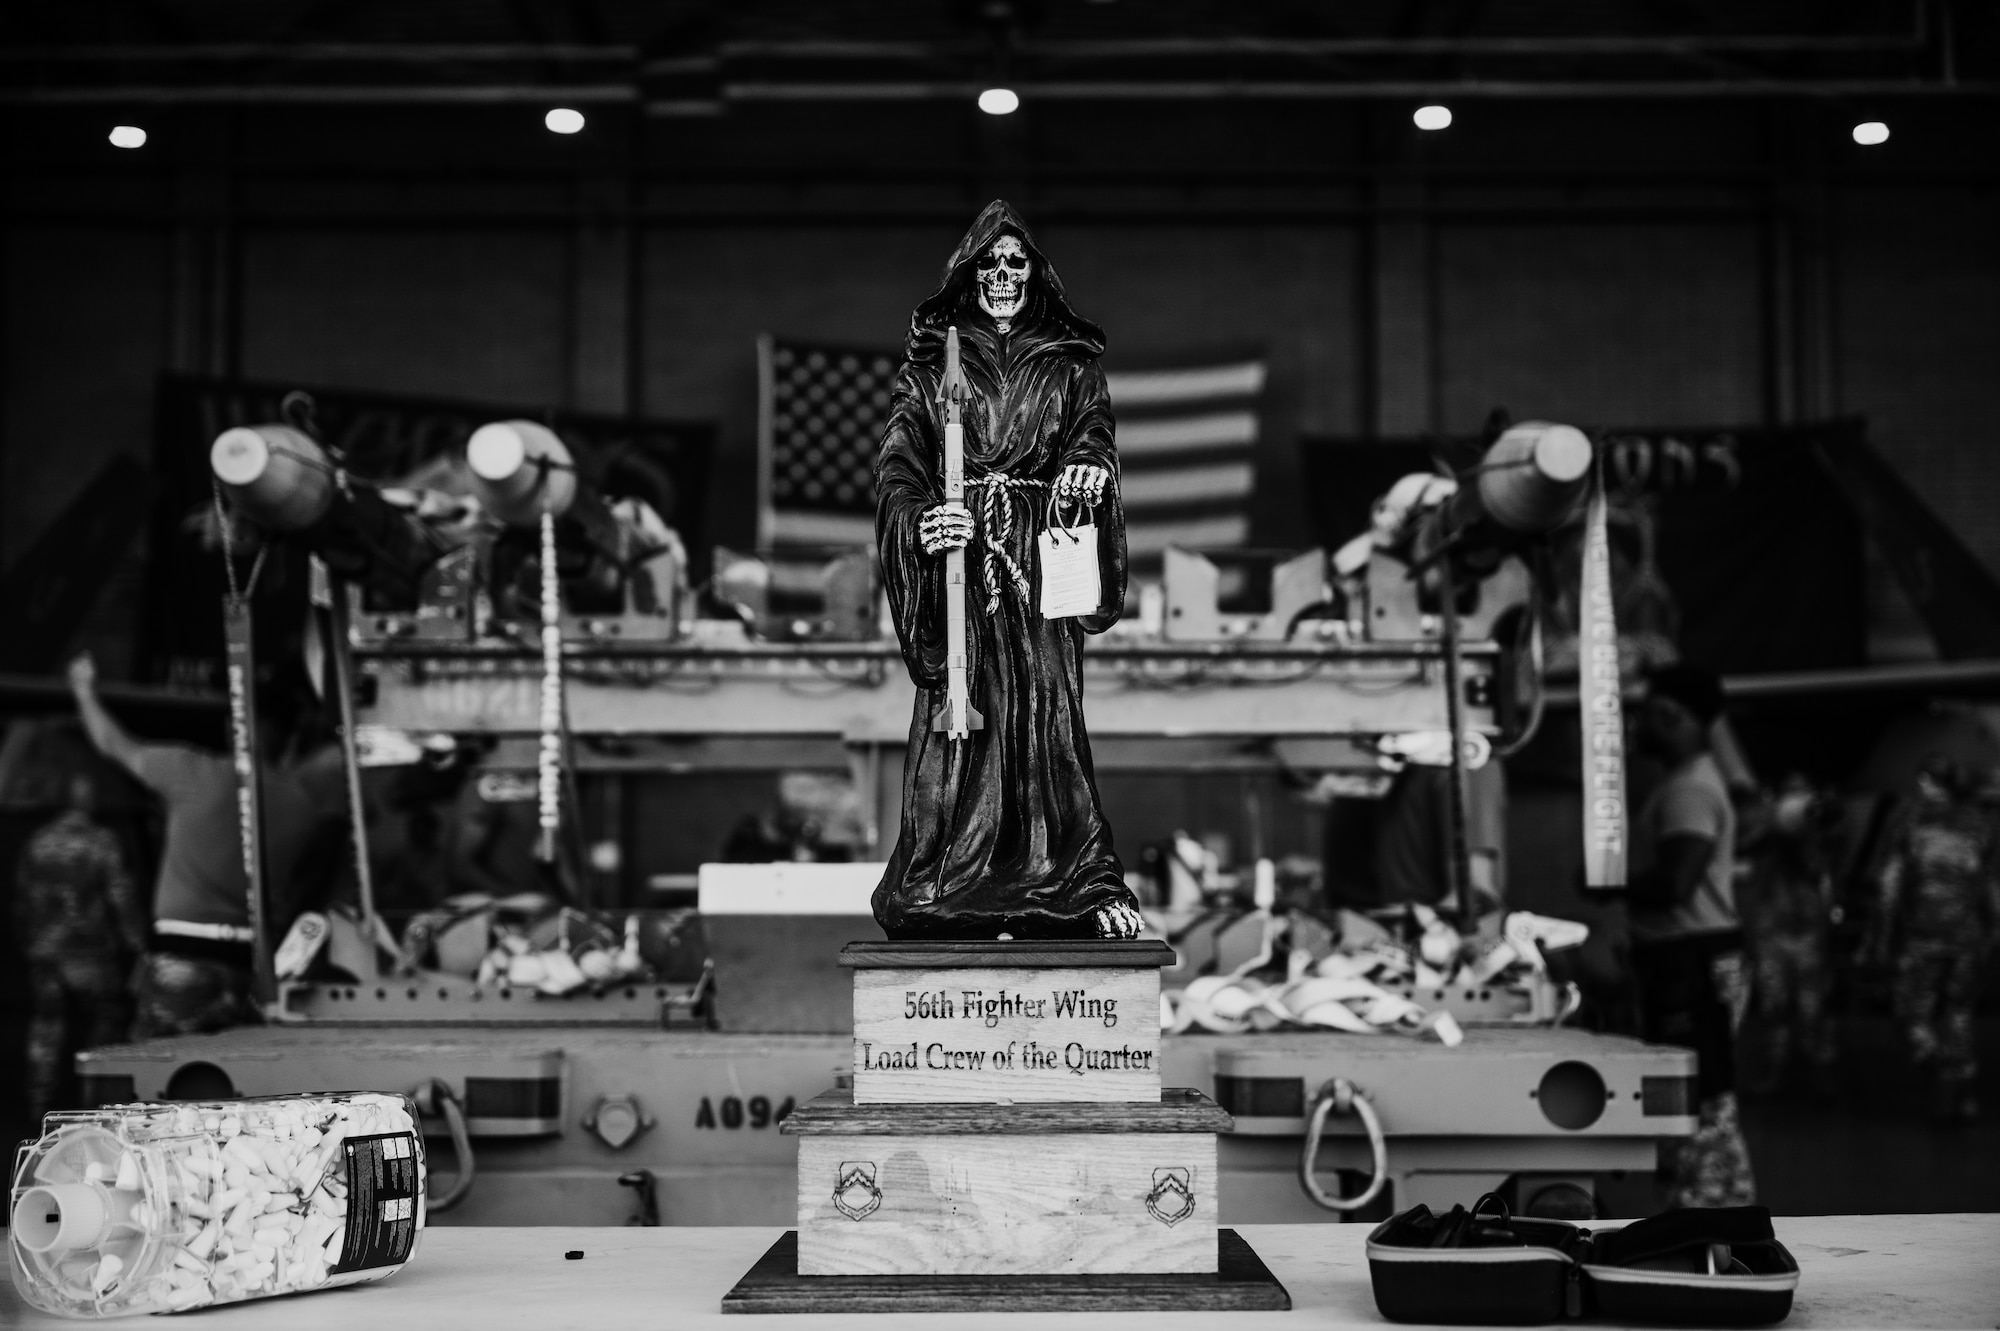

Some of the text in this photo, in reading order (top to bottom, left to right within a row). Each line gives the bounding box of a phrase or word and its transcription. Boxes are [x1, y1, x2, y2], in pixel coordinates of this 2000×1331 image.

[1592, 645, 1620, 750] BEFORE
[1594, 755, 1622, 855] FLIGHT
[904, 989, 1118, 1028] 56th Fighter Wing
[863, 1041, 1153, 1075] Load Crew of the Quarter
